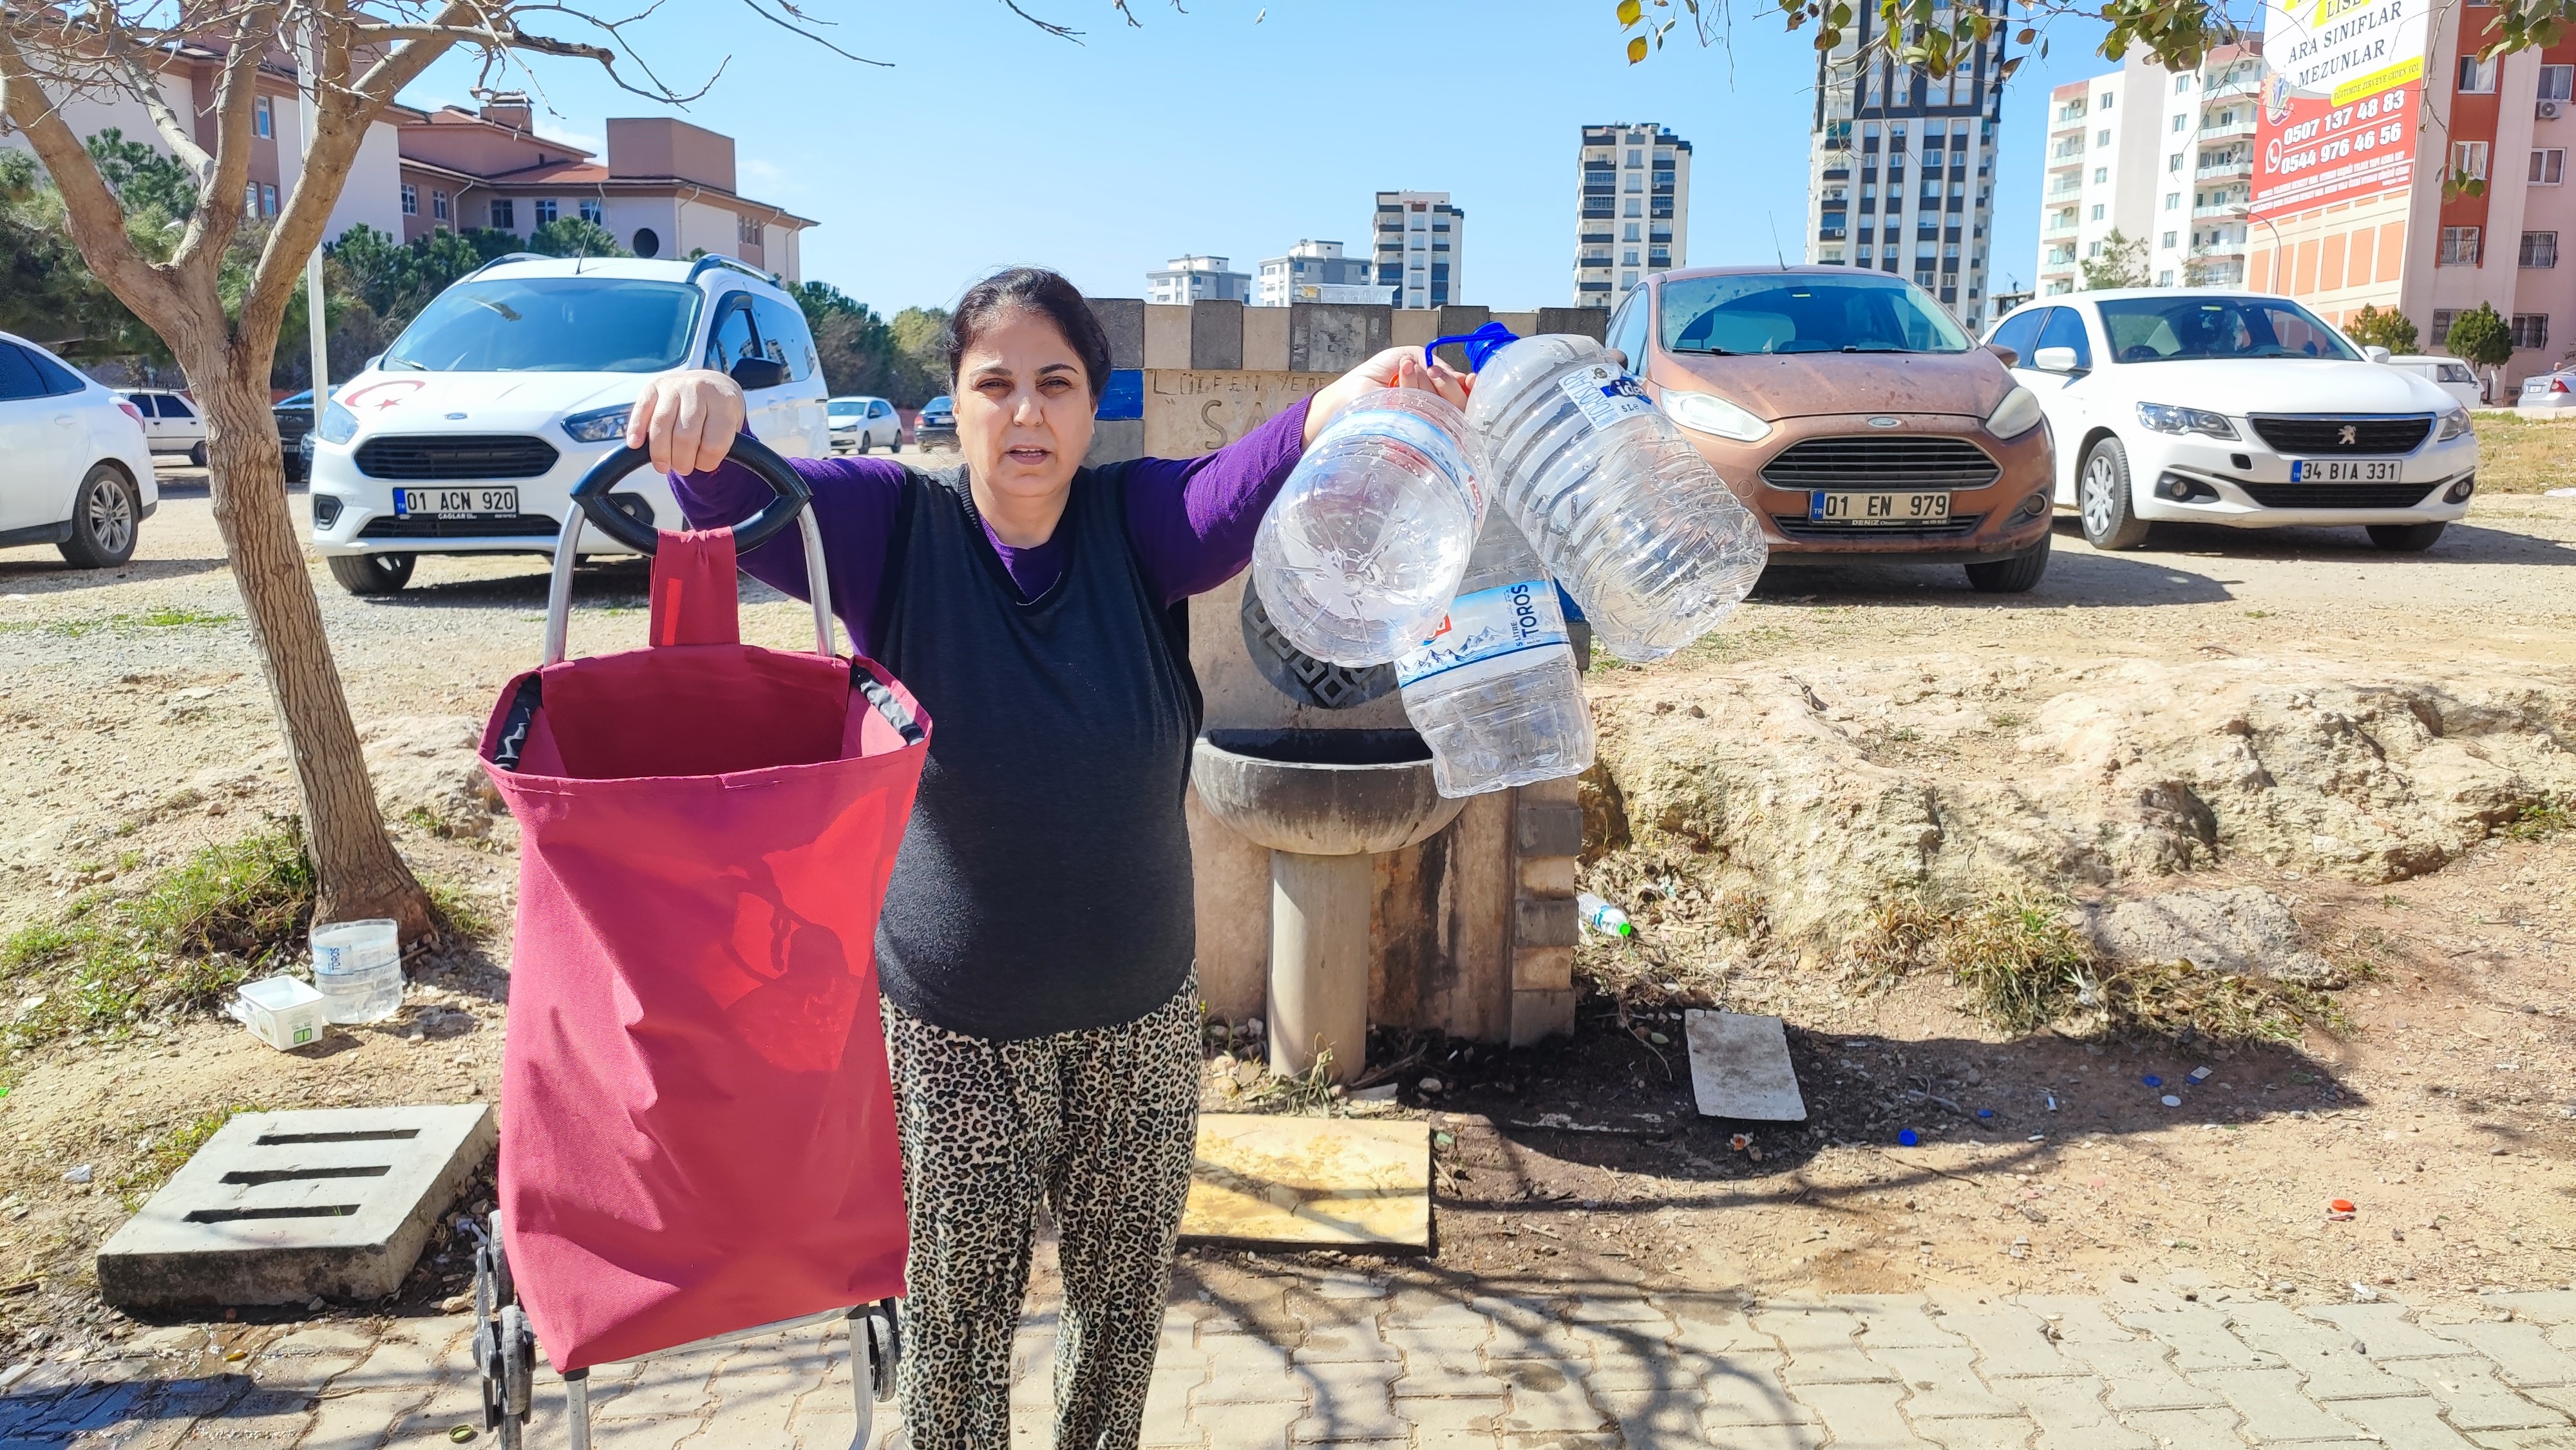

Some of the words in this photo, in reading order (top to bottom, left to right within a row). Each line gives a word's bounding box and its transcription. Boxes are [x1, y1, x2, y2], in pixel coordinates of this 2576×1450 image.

[2288, 37, 2318, 64] ARA
[2324, 3, 2402, 49] SINIFLAR
[2298, 39, 2385, 88] MEZUNLAR
[2284, 118, 2320, 146] 0507
[2324, 106, 2354, 133] 137
[2356, 98, 2378, 120] 48
[2383, 89, 2405, 113] 83
[2280, 149, 2316, 175] 0544
[2320, 138, 2350, 163] 976
[2353, 130, 2376, 152] 46
[2379, 122, 2402, 146] 56
[1564, 372, 1614, 422] TOROSLAR
[2302, 463, 2322, 479] 34
[2329, 463, 2358, 480] BIA
[2366, 464, 2395, 480] 331
[407, 493, 426, 511] 01
[440, 492, 471, 511] ACN
[482, 492, 513, 510] 920
[1825, 496, 1848, 516] 01
[1868, 496, 1892, 516] EN
[1910, 495, 1947, 516] 979
[1510, 585, 1539, 638] TOROS
